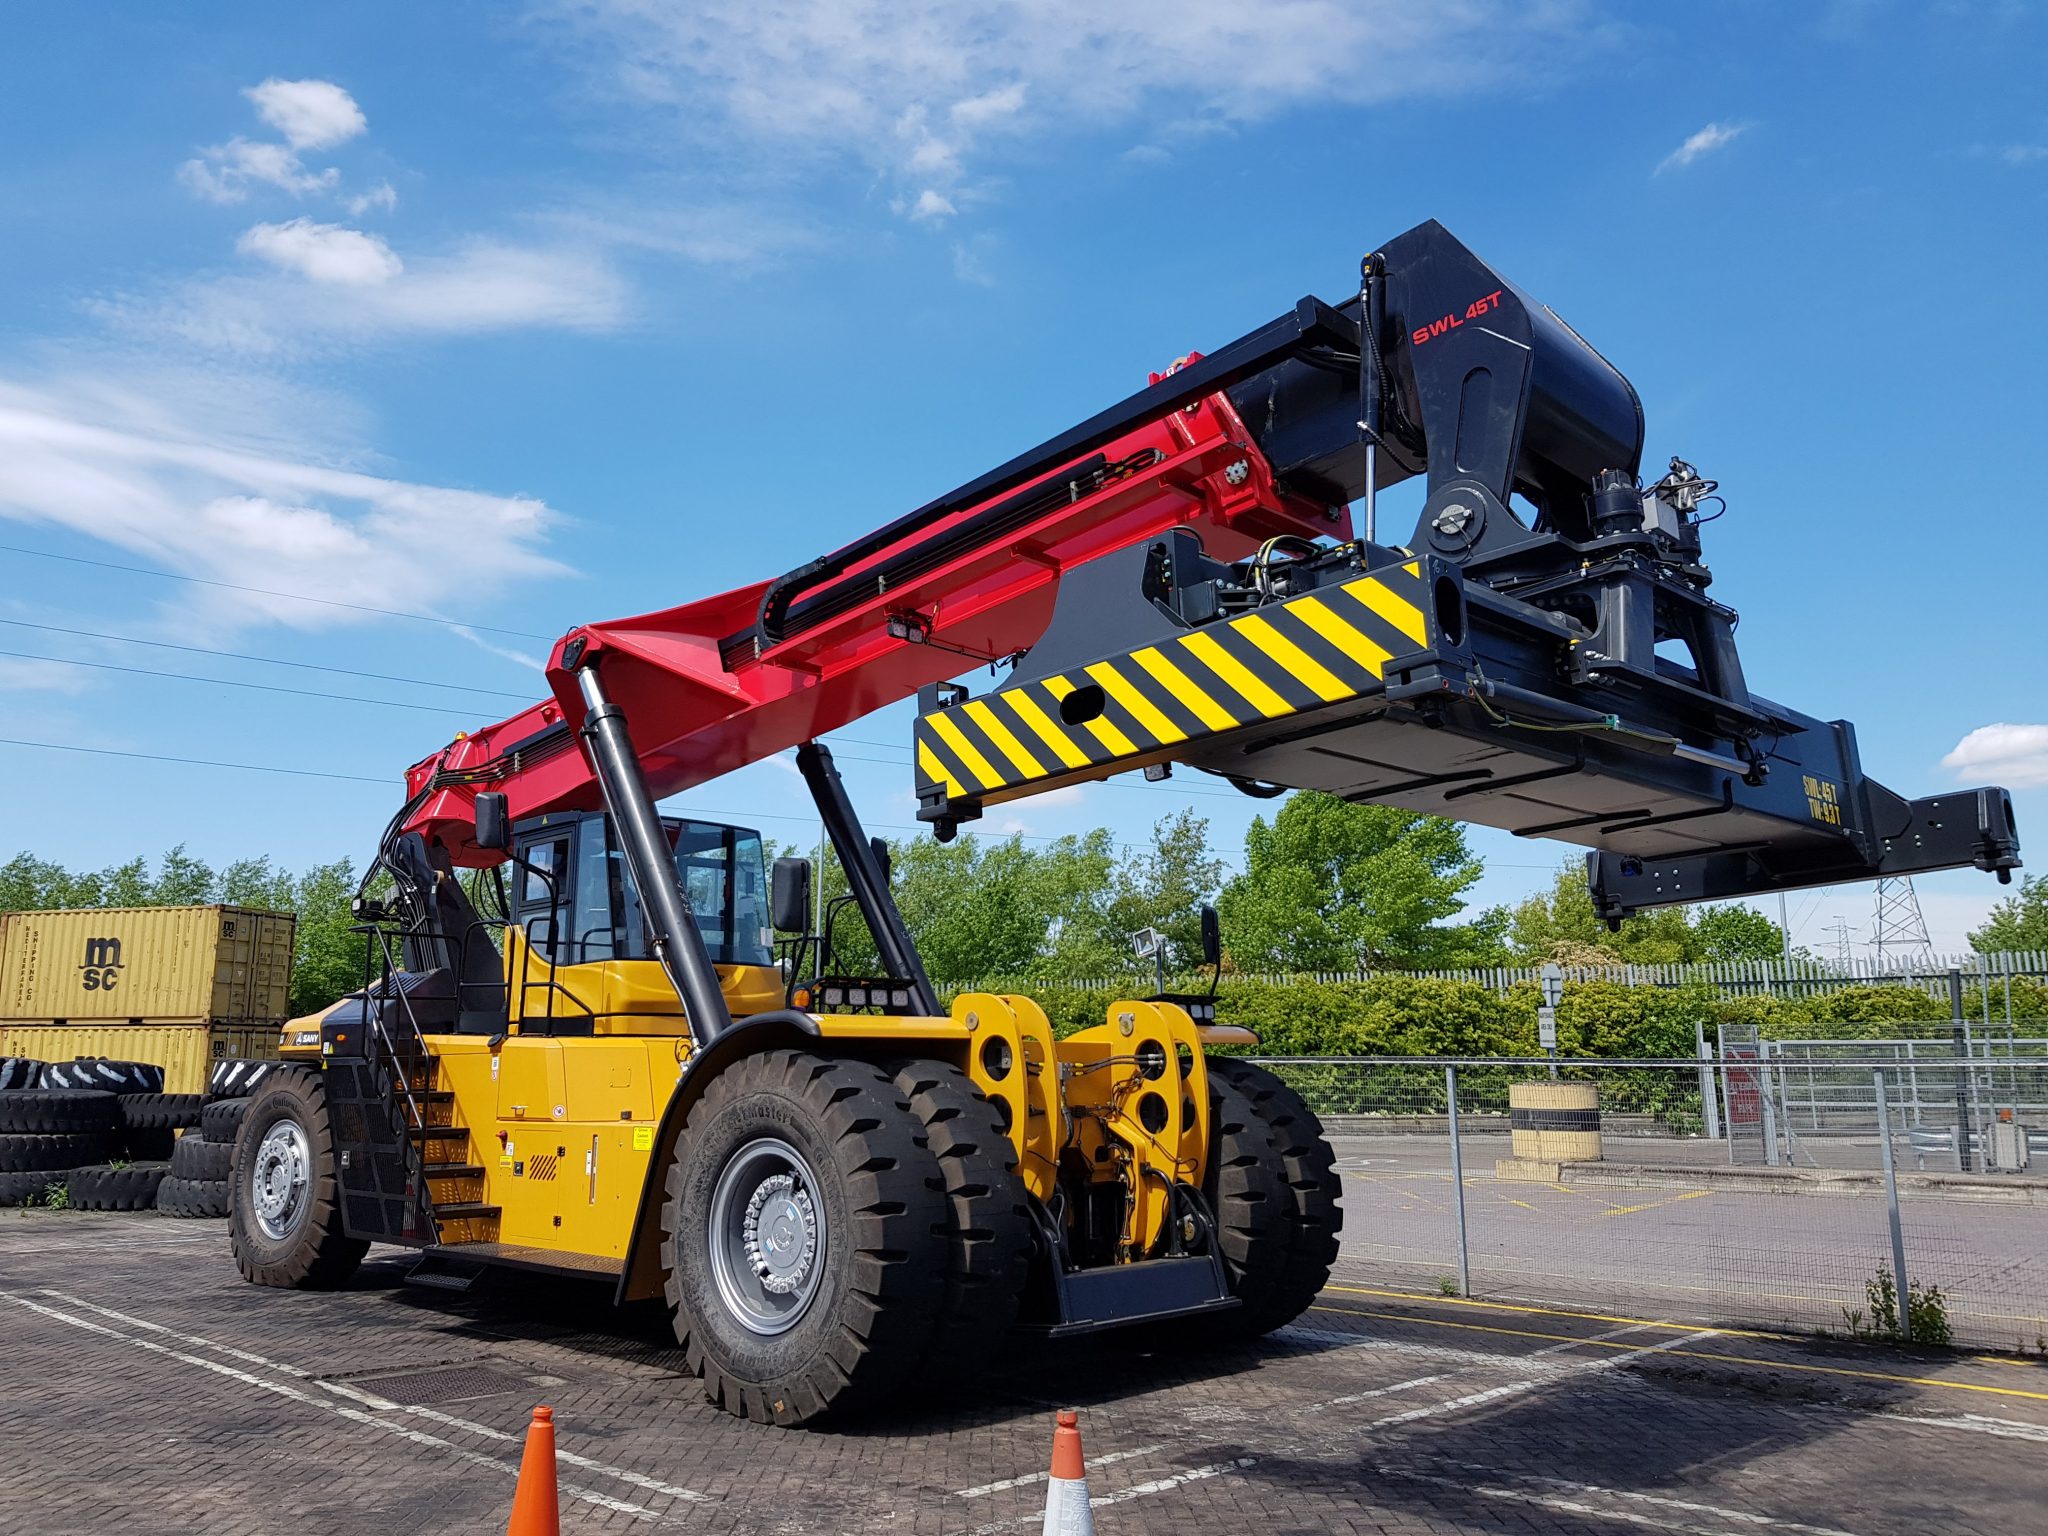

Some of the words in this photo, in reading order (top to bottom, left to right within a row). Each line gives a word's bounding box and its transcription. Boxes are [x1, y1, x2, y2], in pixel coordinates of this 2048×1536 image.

[1412, 313, 1464, 345] SWL
[1465, 290, 1502, 319] 45T
[302, 1033, 320, 1043] SANY
